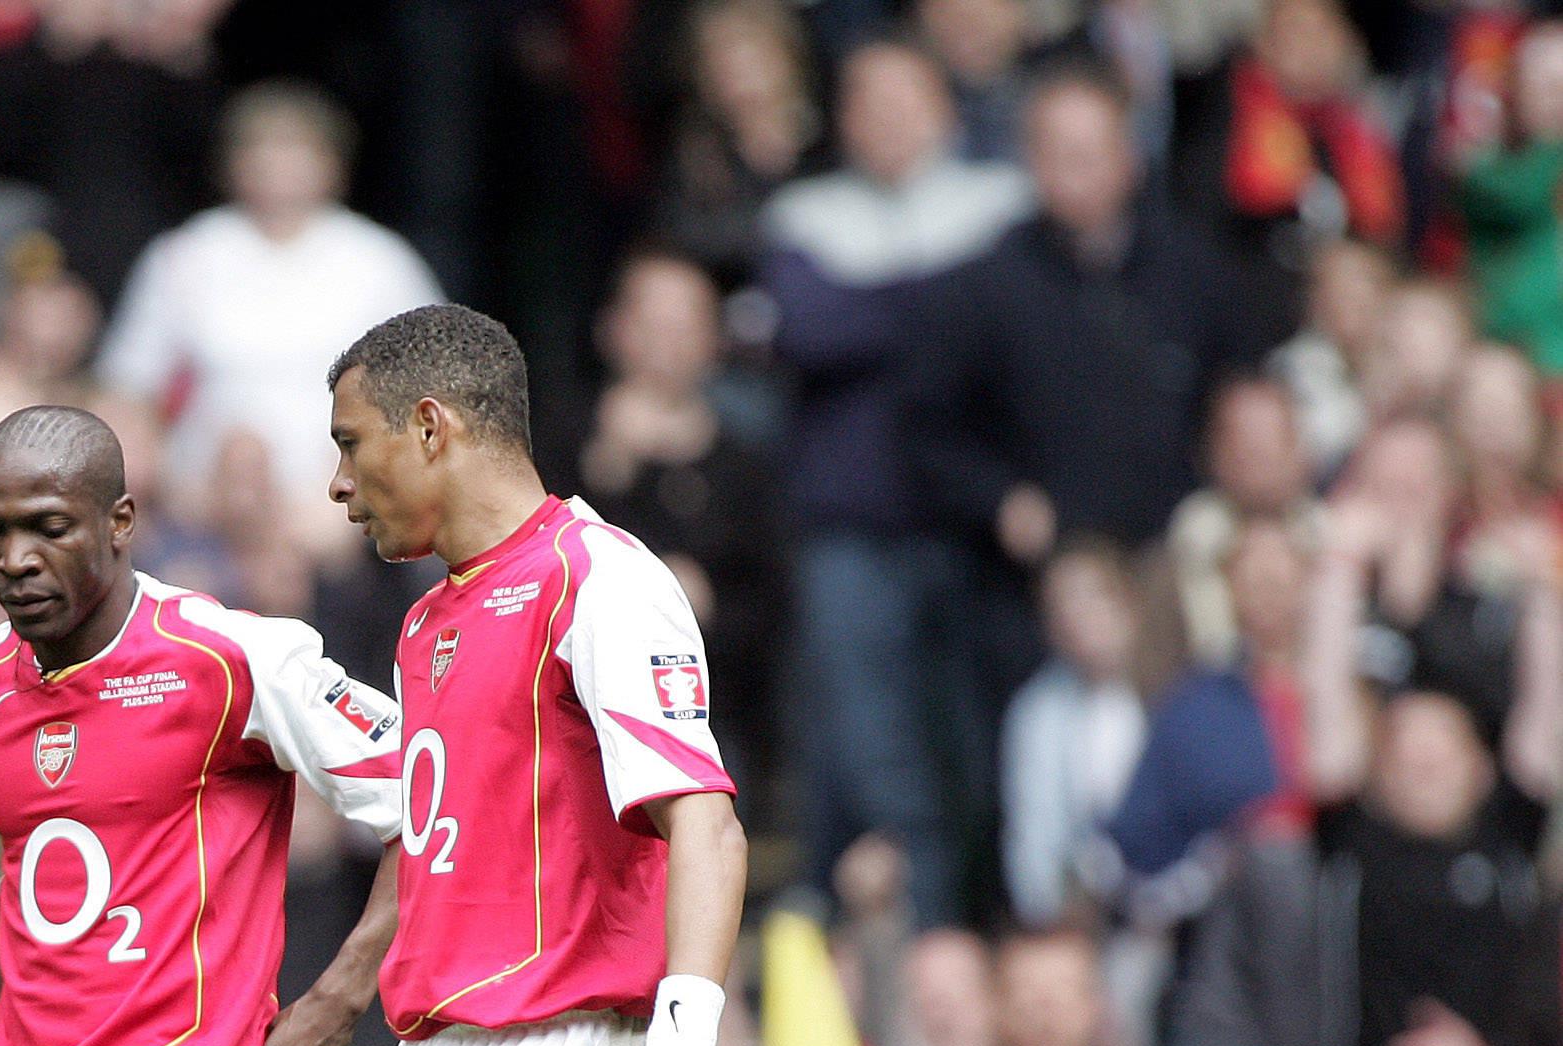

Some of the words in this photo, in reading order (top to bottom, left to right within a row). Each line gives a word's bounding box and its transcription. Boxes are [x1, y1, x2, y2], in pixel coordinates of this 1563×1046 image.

[104, 678, 122, 688] THE
[124, 676, 135, 686] FA
[136, 674, 152, 684] CUP
[154, 671, 179, 682] FINAL
[99, 685, 150, 700] MILLENNIUM
[150, 680, 187, 694] STADIUM
[674, 709, 697, 720] CUP
[41, 732, 72, 744] Arsenal
[402, 727, 460, 874] O2
[20, 817, 146, 963] O2
